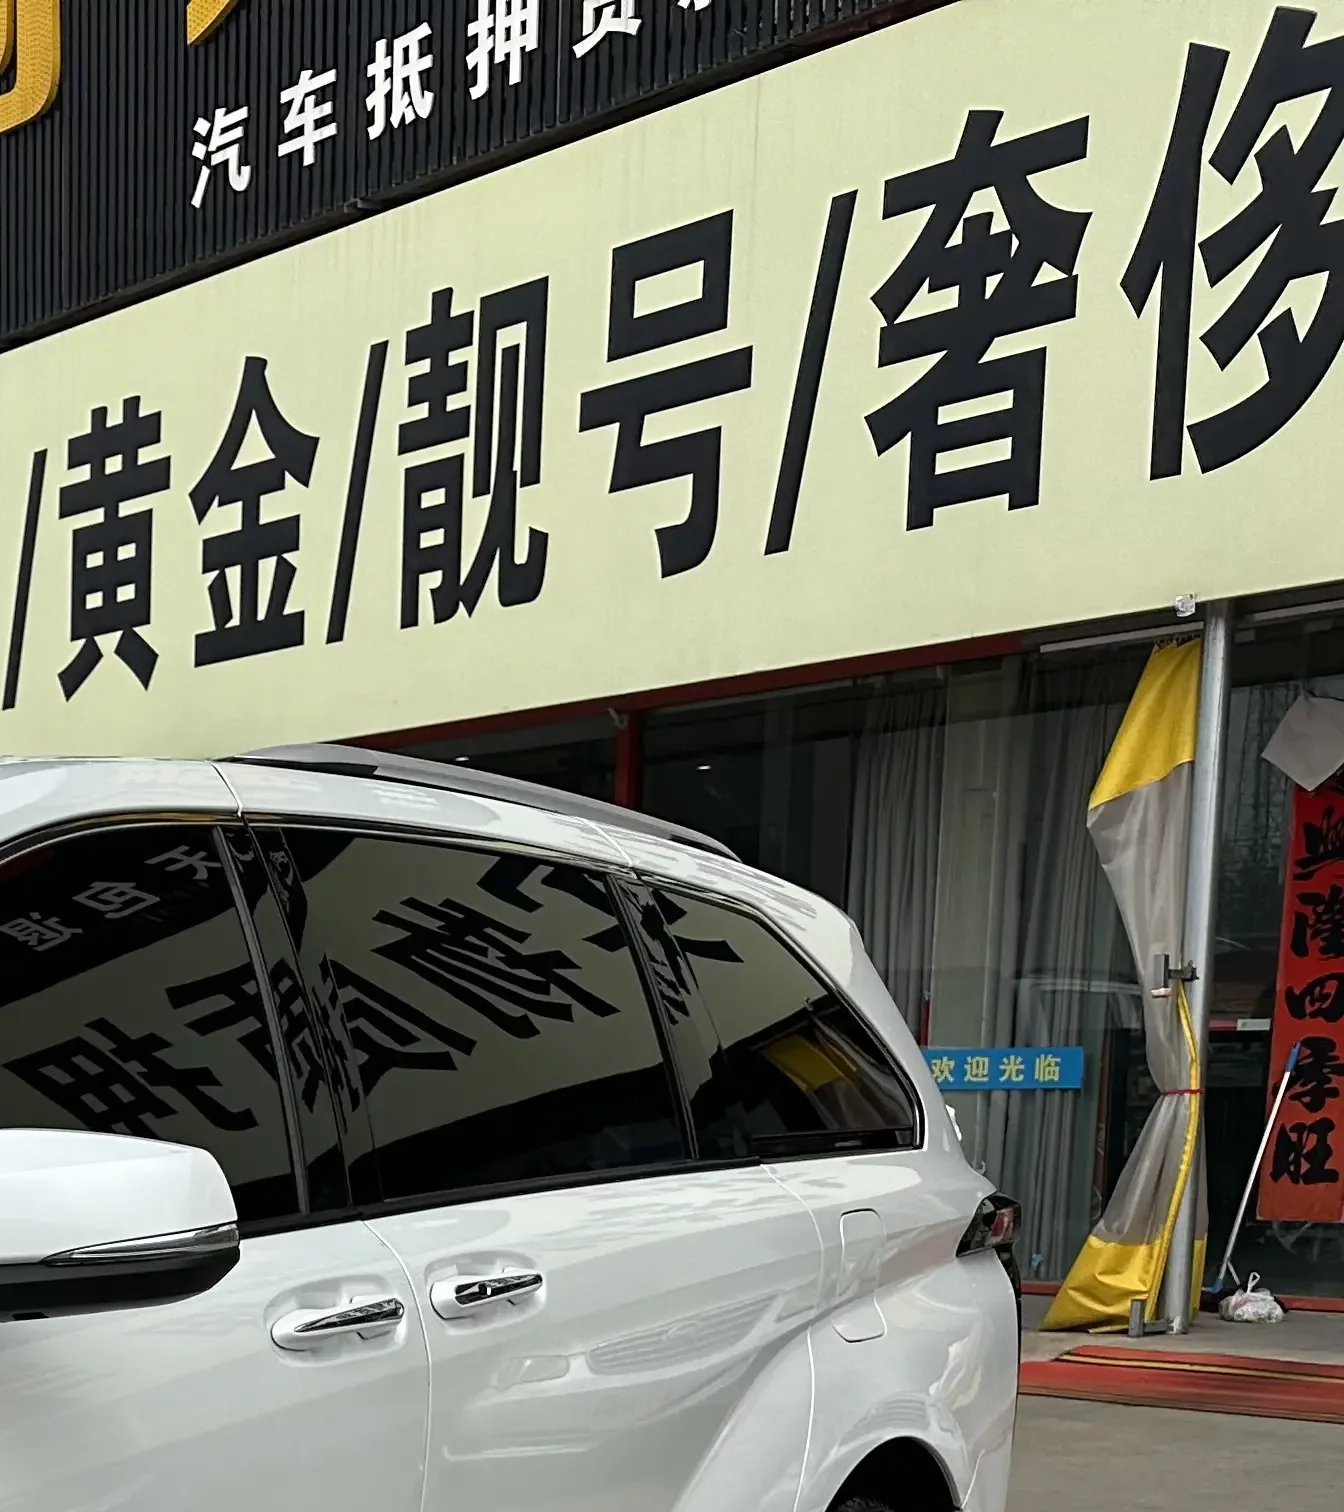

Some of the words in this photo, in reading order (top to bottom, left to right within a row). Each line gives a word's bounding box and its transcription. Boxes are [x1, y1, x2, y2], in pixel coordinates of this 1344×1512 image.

[189, 0, 712, 208] 汽车抵押
[931, 1054, 1061, 1083] 欢迎光临
